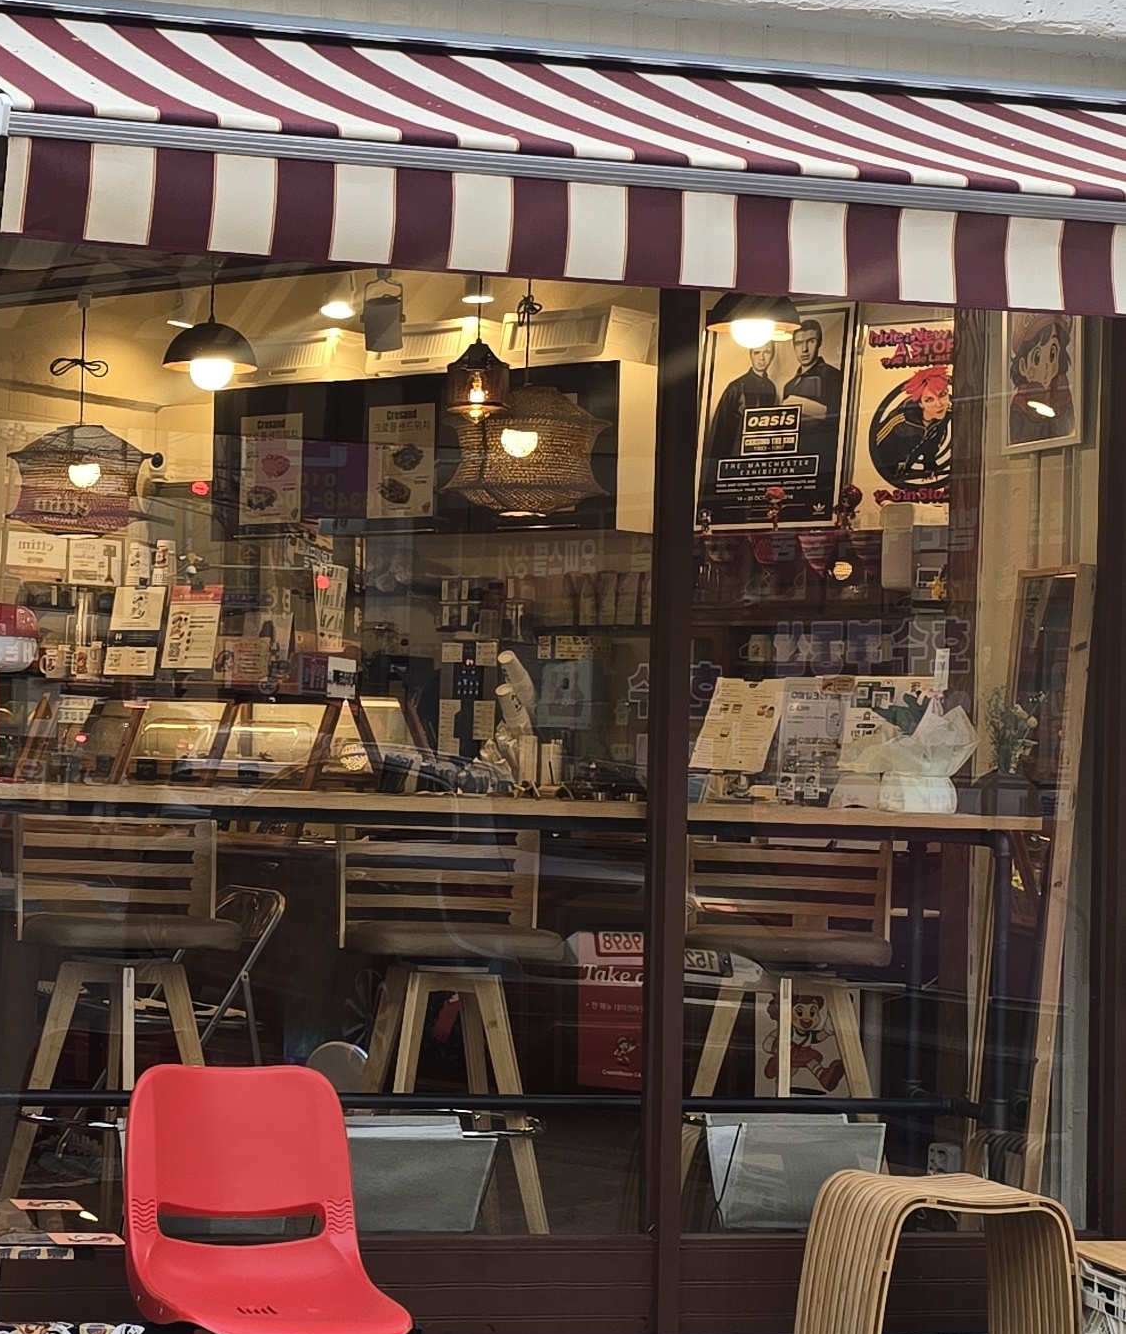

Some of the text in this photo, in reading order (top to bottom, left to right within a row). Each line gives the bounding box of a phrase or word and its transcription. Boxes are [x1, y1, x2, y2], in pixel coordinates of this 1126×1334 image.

[747, 411, 796, 427] oasis
[747, 459, 810, 469] MANCHESTER
[740, 468, 796, 476] EXHIBITION
[582, 963, 631, 985] Take
